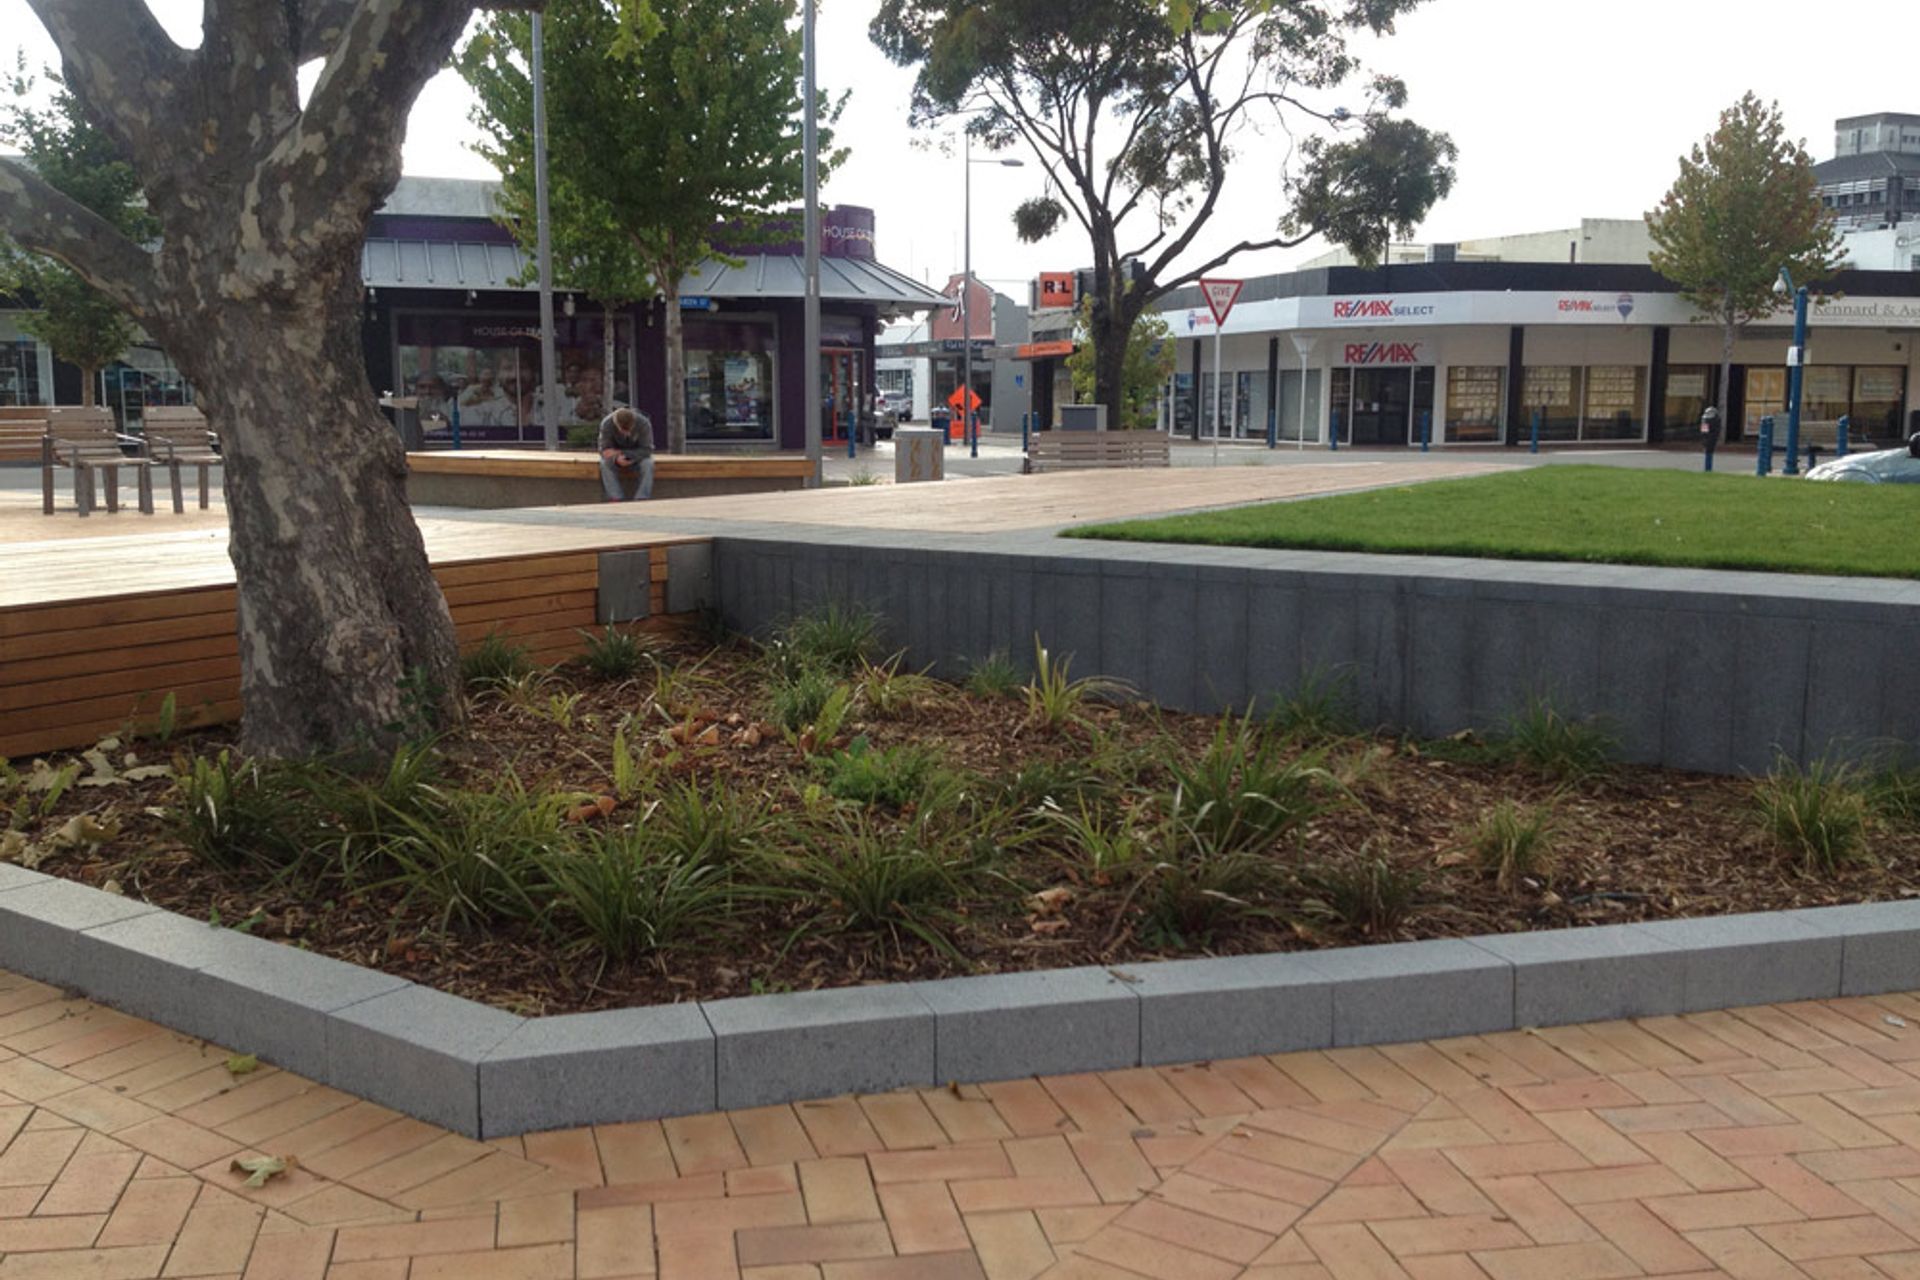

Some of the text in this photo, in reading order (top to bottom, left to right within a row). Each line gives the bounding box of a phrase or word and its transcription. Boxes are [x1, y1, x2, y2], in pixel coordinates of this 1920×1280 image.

[823, 225, 855, 238] HOUSE
[1212, 287, 1231, 297] GIVE
[1334, 299, 1435, 318] RE/MAX SELECT
[1813, 302, 1878, 317] Kennard
[1883, 304, 1896, 317] &
[473, 326, 506, 336] HOUSE
[1344, 342, 1418, 364] RE/MAX
